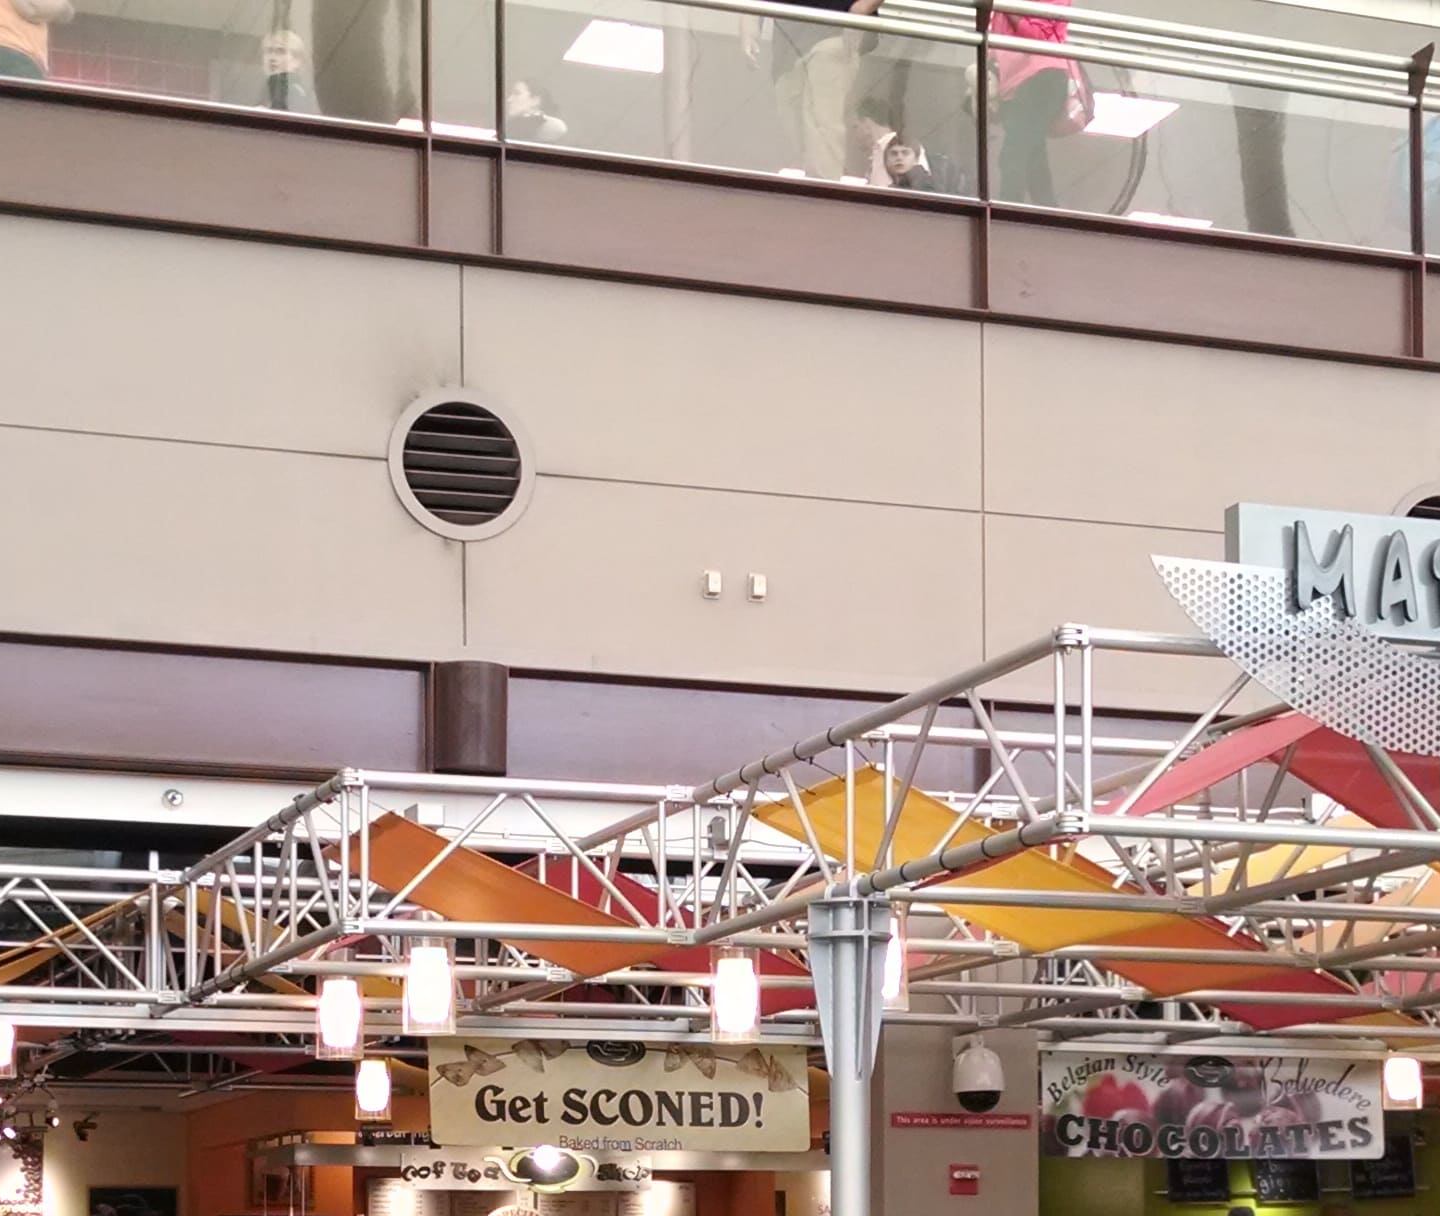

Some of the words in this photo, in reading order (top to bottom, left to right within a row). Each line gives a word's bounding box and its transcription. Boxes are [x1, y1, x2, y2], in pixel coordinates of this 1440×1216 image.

[1046, 1056, 1117, 1104] Belgian
[1122, 1054, 1171, 1088] Style
[1258, 1056, 1373, 1112] Belvedere
[474, 1084, 550, 1124] Get
[560, 1087, 765, 1129] SCONED!
[559, 1135, 600, 1150] Baked
[602, 1137, 632, 1150] from
[635, 1137, 682, 1151] Scratch
[1055, 1113, 1374, 1158] CHOCOLATES
